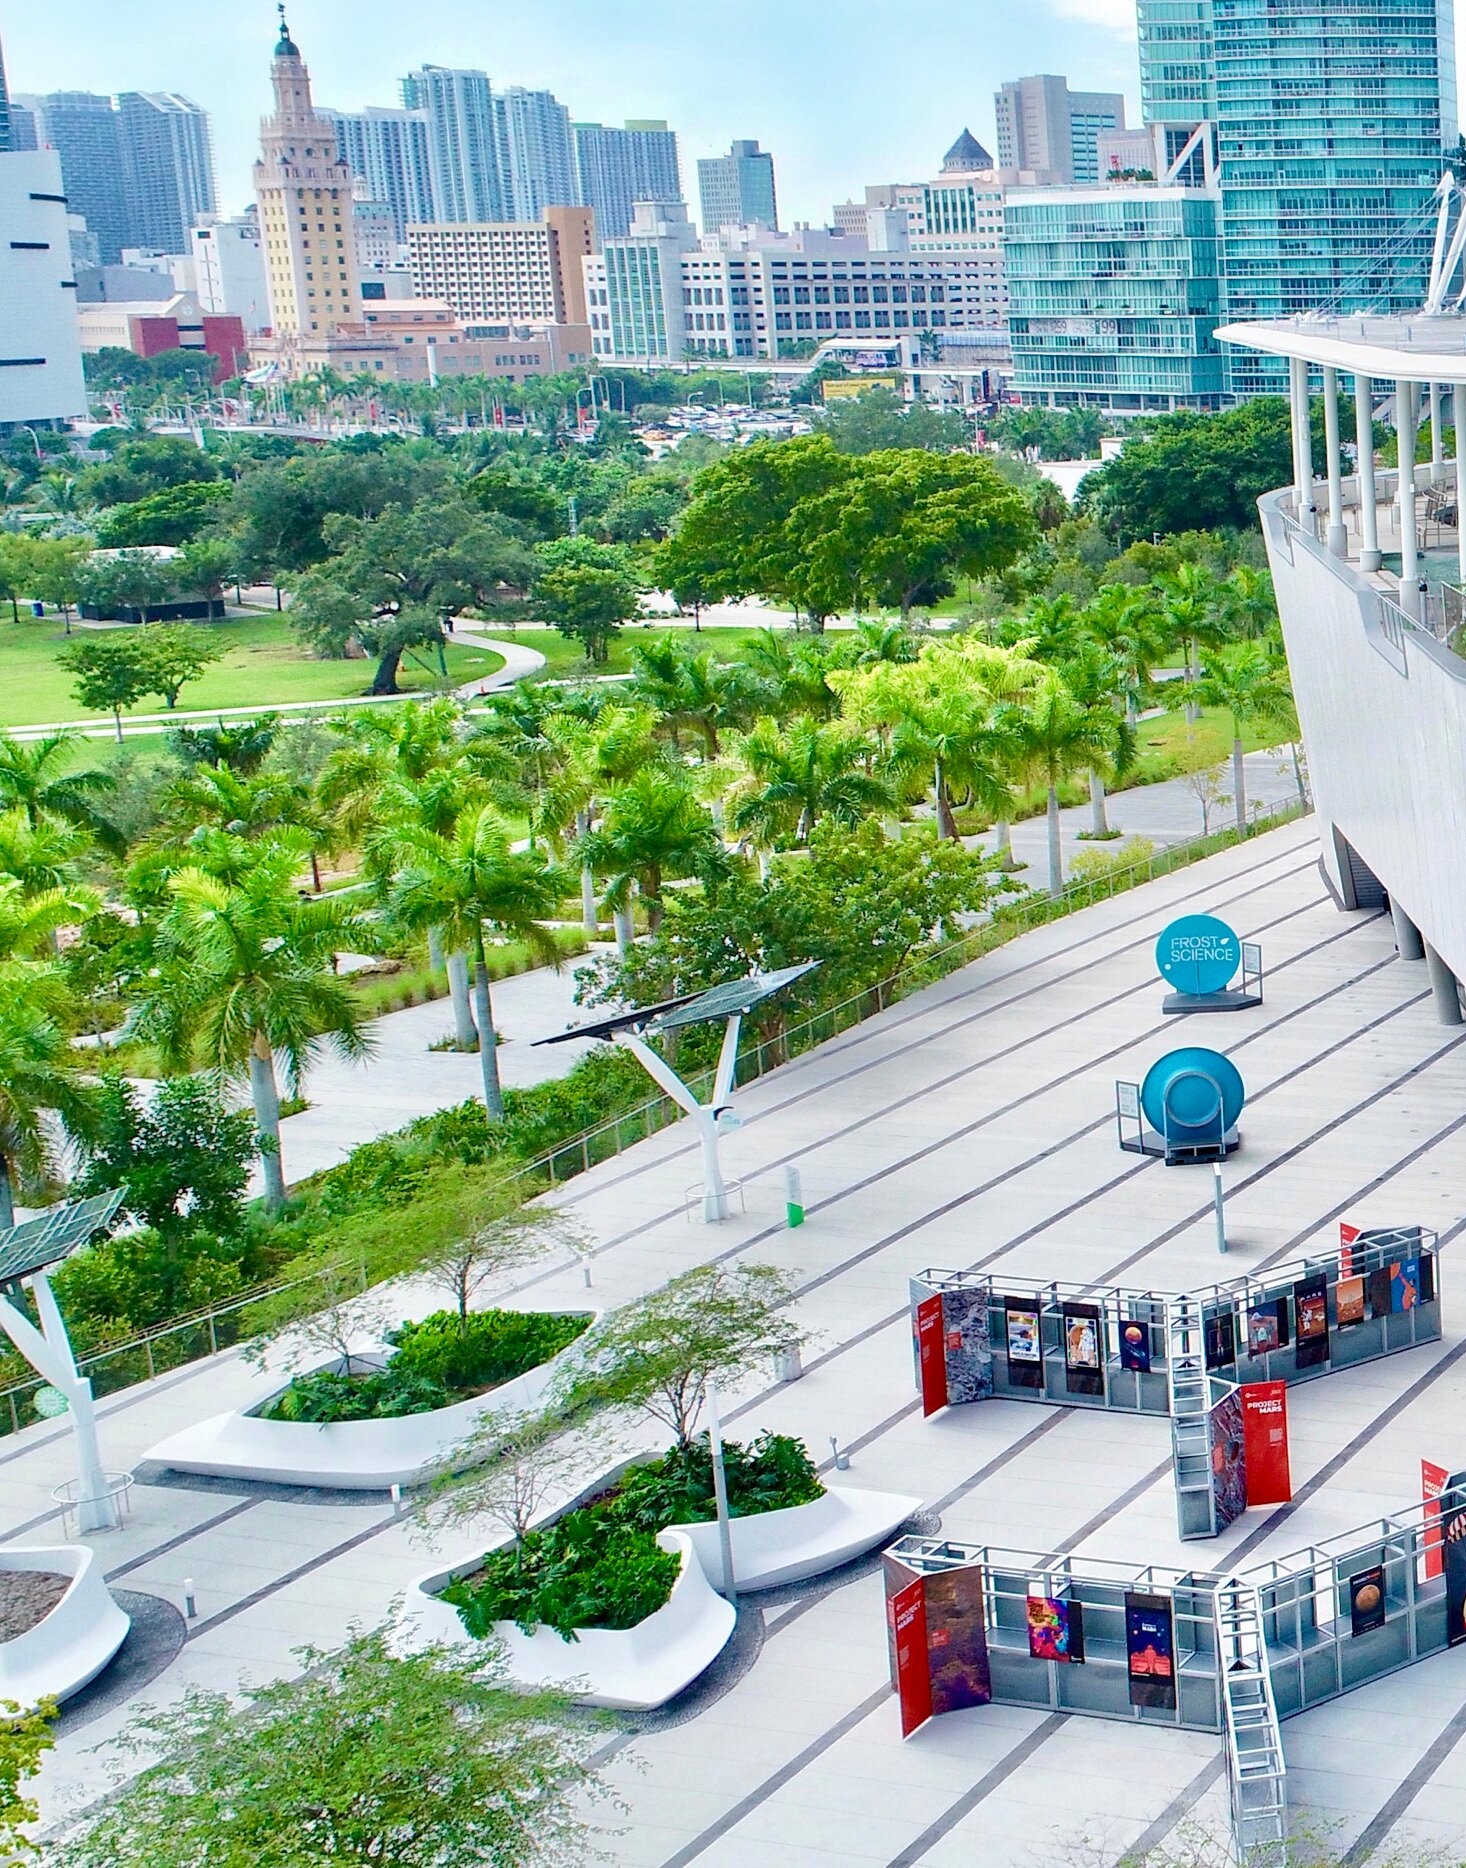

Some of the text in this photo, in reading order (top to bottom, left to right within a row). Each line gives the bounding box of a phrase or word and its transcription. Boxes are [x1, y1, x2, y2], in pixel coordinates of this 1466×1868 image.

[1171, 936, 1219, 949] FROST
[1171, 948, 1233, 962] SCIENCE
[1246, 1399, 1282, 1410] PROJECT
[1259, 1406, 1282, 1414] MARS
